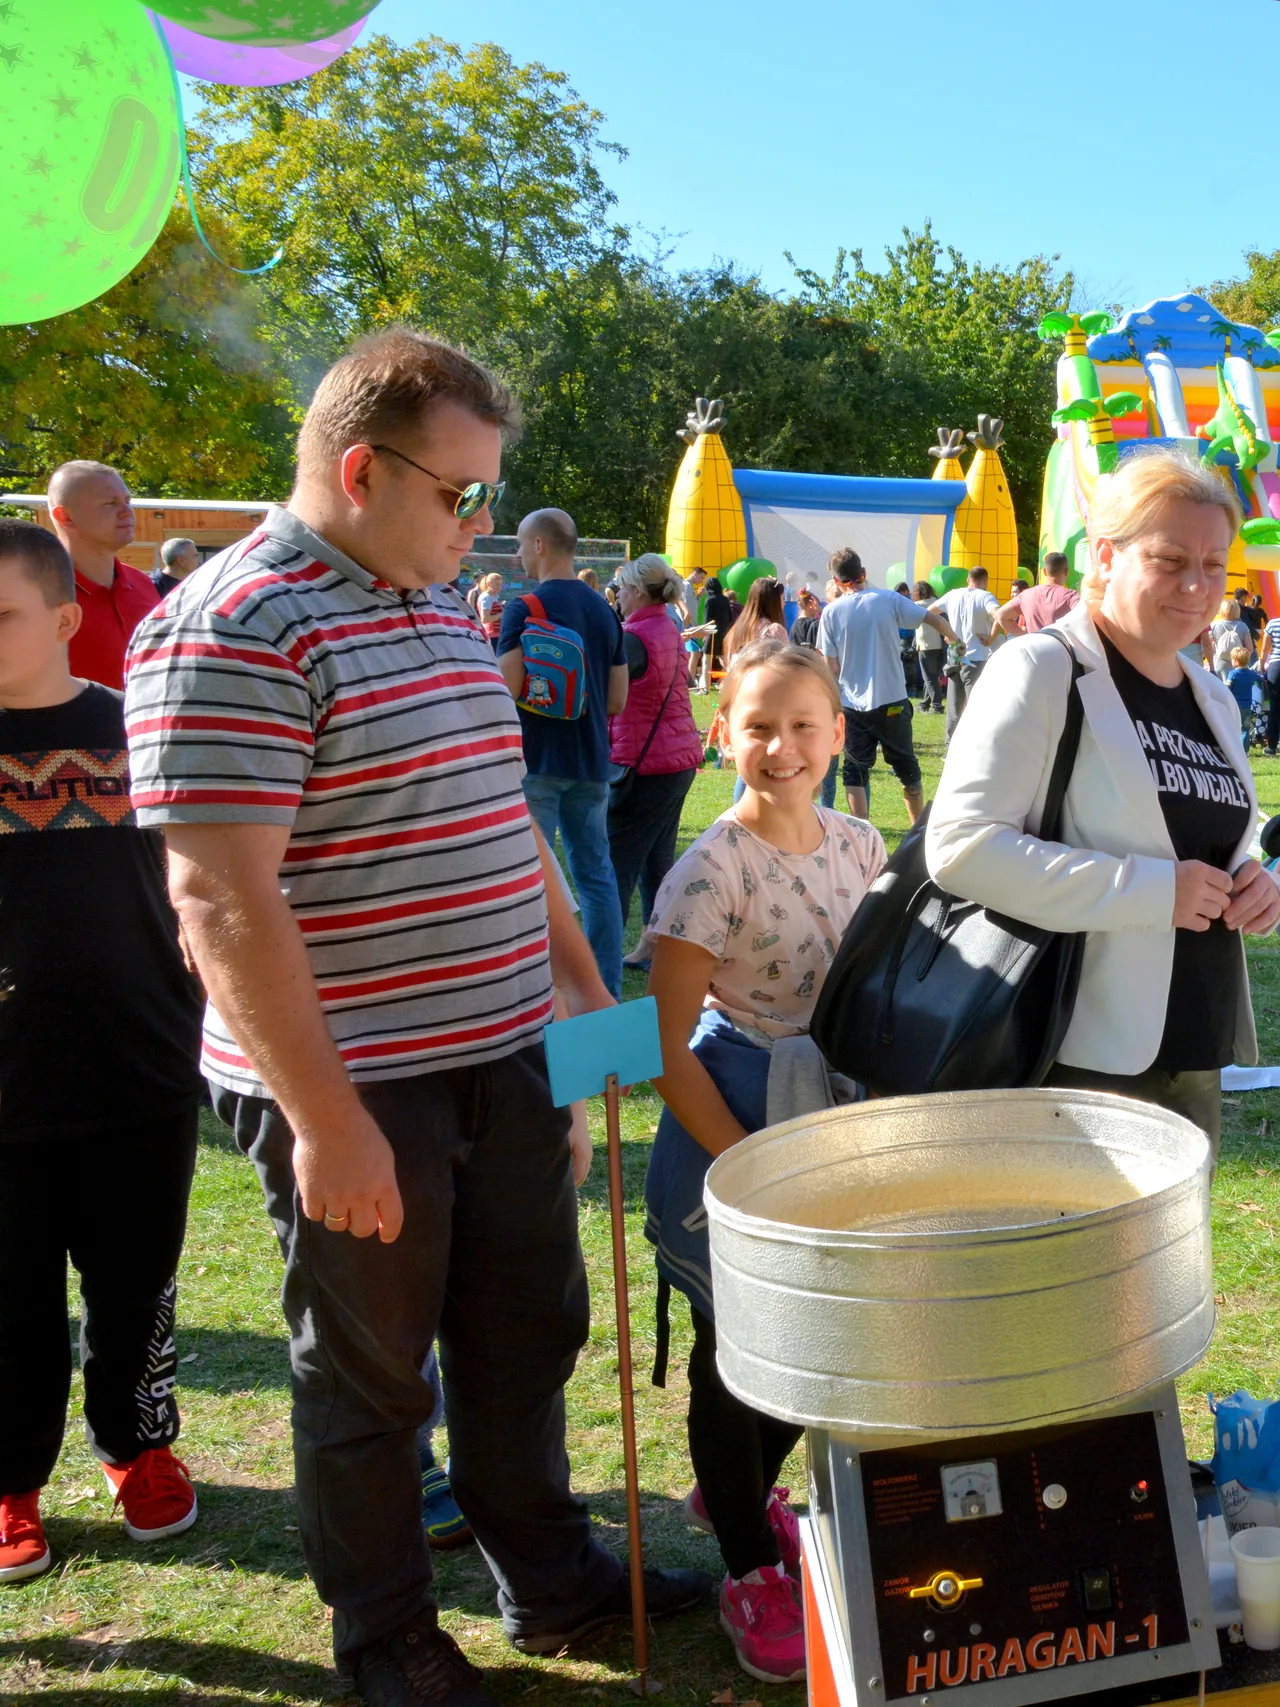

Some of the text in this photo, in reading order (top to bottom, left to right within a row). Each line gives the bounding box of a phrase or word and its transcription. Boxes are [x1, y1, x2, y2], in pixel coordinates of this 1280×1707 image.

[1187, 766, 1249, 809] WCALE
[1029, 1580, 1070, 1593] REGULATOR
[905, 1622, 1116, 1692] HURAGAN
